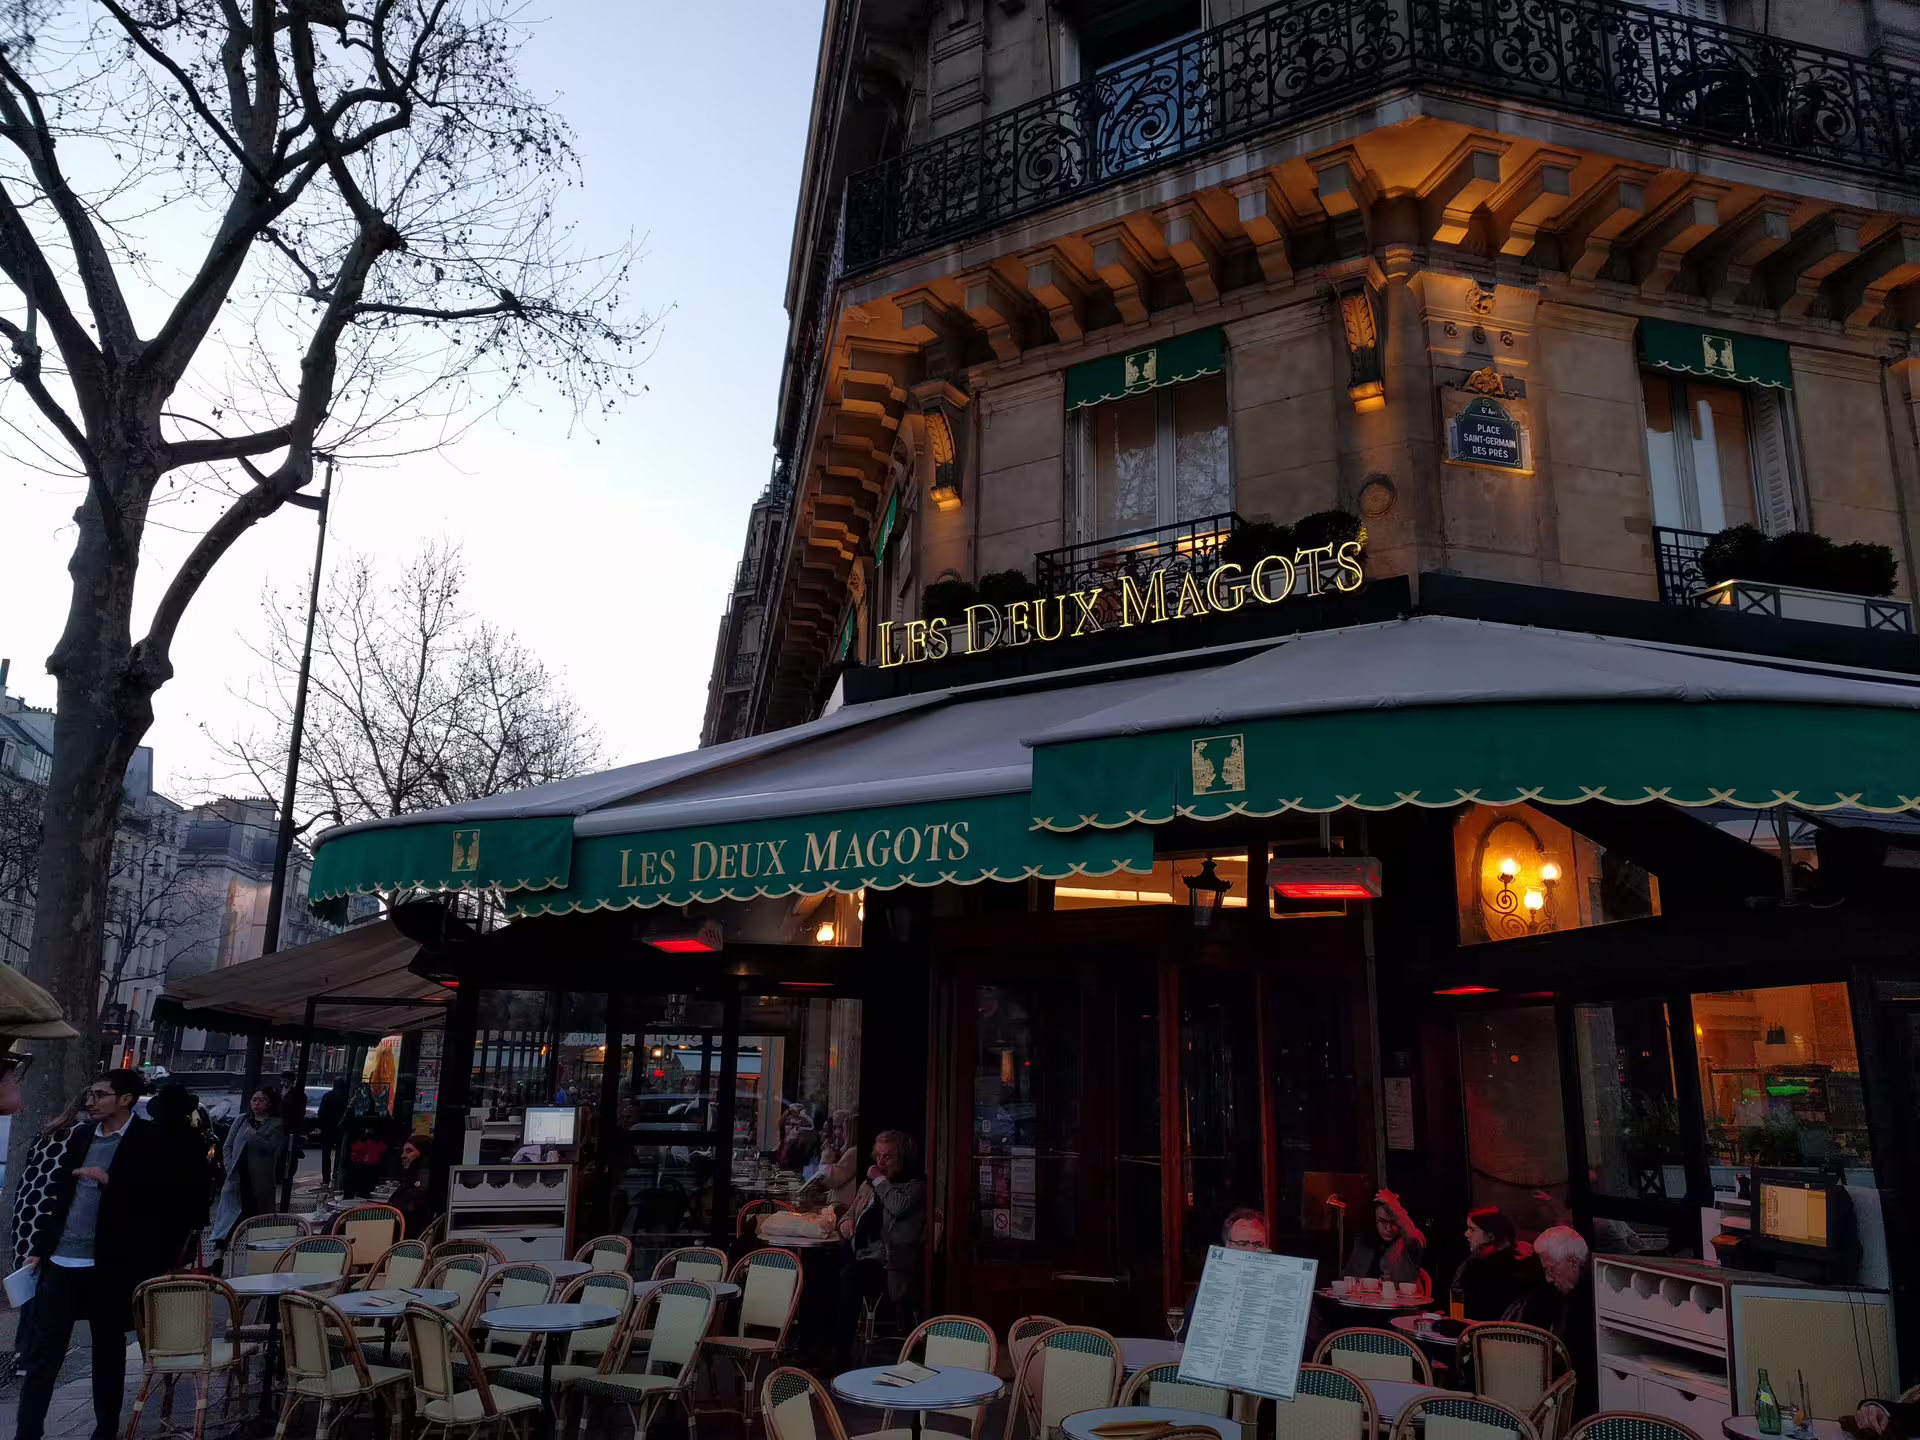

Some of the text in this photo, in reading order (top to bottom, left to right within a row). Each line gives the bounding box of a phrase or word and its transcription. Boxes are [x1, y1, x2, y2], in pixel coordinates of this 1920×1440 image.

[1477, 424, 1501, 434] PLACE
[1463, 433, 1516, 448] SAINT-GERMAIN
[1472, 446, 1509, 459] DES PRÉS
[878, 541, 1364, 669] LES DEUX MAGOTS
[617, 821, 970, 888] LES DEUX MAGOTS
